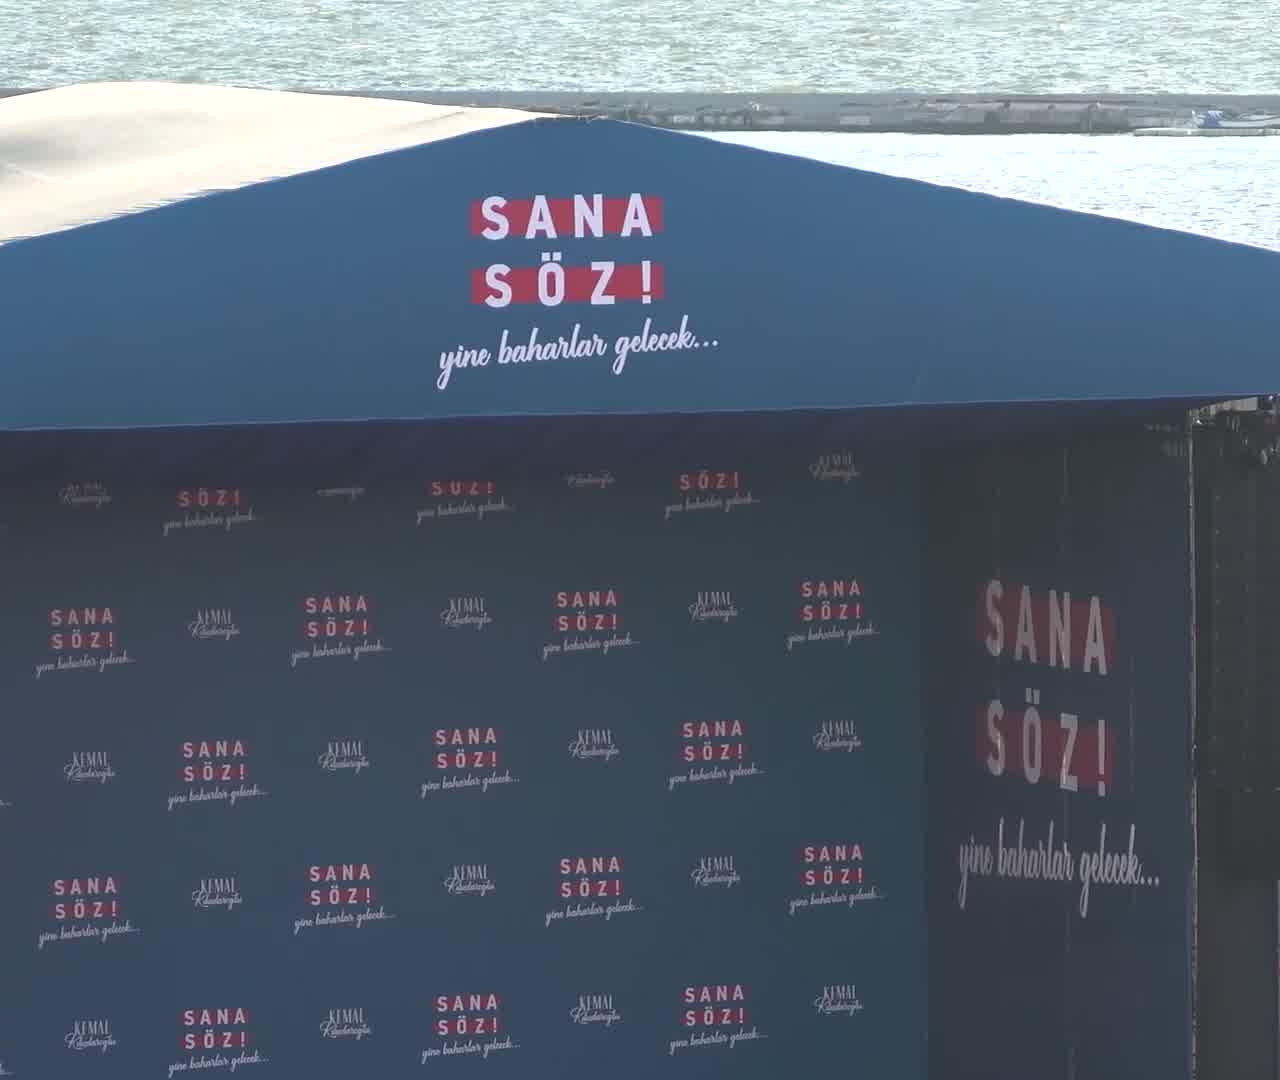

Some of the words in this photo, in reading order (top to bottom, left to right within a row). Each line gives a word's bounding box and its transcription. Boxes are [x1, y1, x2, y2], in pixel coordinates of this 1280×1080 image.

[481, 193, 653, 241] SANA
[484, 251, 652, 308] SÖZ!
[436, 345, 491, 390] yine
[497, 323, 607, 364] baharlar
[557, 590, 617, 608] SANA
[802, 580, 860, 598] SANA
[306, 595, 367, 614] SANA
[803, 600, 860, 621] SÖZ!
[51, 607, 113, 626] SANA
[558, 611, 617, 631] SÖZ!
[307, 617, 367, 637] SÖZ!
[984, 579, 1108, 675] SANA
[52, 629, 113, 649] SÖZ!
[436, 727, 496, 745] SANA
[683, 720, 742, 738] SANA
[183, 740, 244, 758] SANA
[684, 741, 742, 762] SÖZ!
[986, 688, 1107, 797] SÖZ!
[437, 748, 496, 769] SÖZ!
[184, 761, 244, 782] SÖZ!
[804, 844, 862, 862] SANA
[998, 816, 1074, 881] baharlar
[310, 864, 371, 882] SANA
[560, 856, 620, 874] SANA
[805, 865, 862, 886] SÖZ!
[54, 877, 116, 896] SANA
[311, 885, 370, 905] SÖZ!
[561, 877, 620, 898] SÖZ!
[55, 898, 116, 919] SÖZ!
[437, 994, 498, 1012] SANA
[685, 984, 744, 1003] SANA
[184, 1008, 246, 1026] SANA
[438, 1015, 497, 1035] SÖZ!
[686, 1006, 743, 1026] SÖZ!
[185, 1029, 245, 1049] SÖZ!
